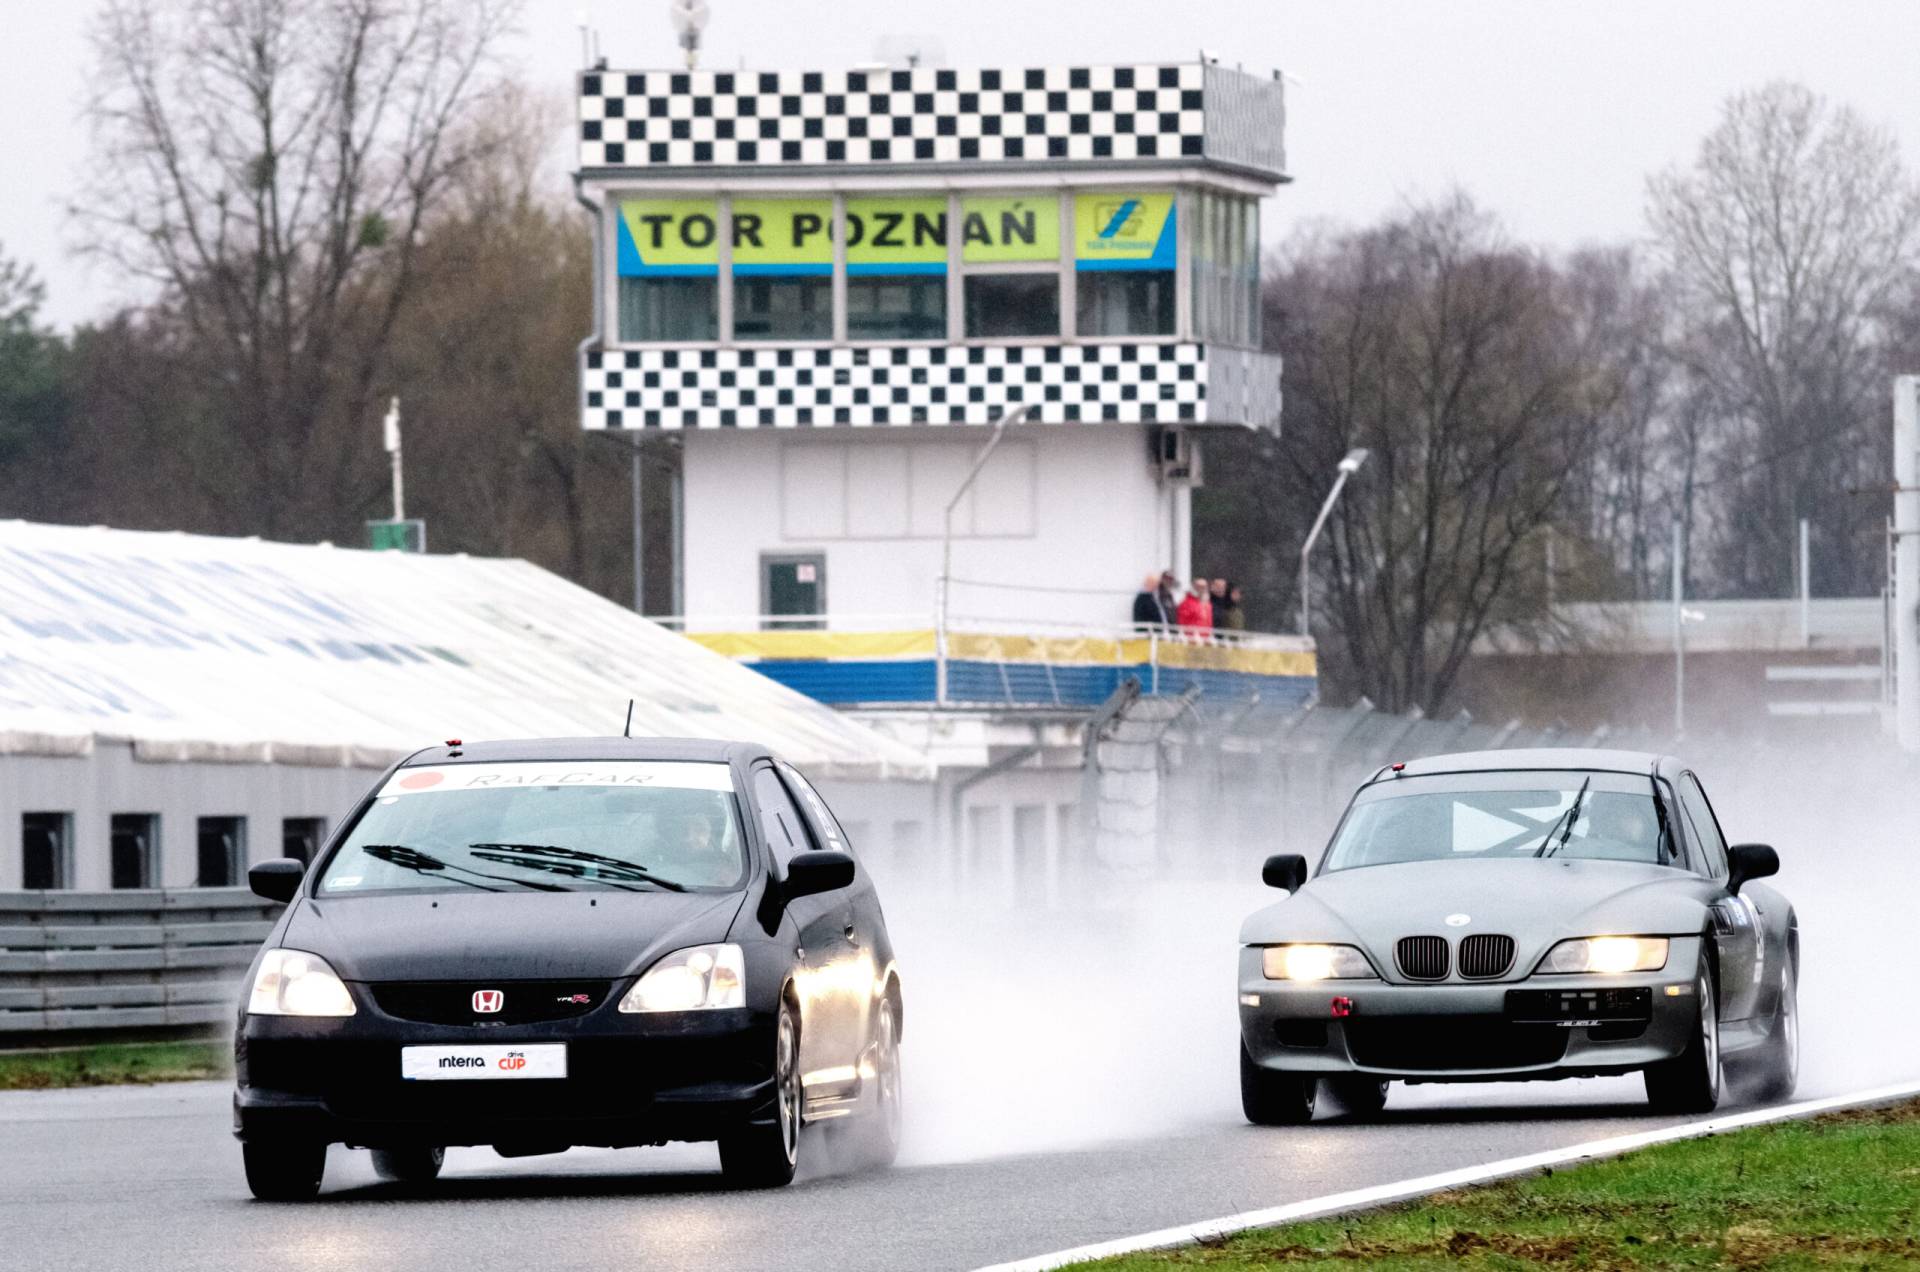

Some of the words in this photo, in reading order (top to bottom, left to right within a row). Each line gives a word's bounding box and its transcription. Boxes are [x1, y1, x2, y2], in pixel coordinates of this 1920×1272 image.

[639, 213, 764, 249] TOR
[792, 201, 1036, 249] POZNAŃ
[439, 1055, 486, 1068] interia
[498, 1057, 526, 1071] CUP
